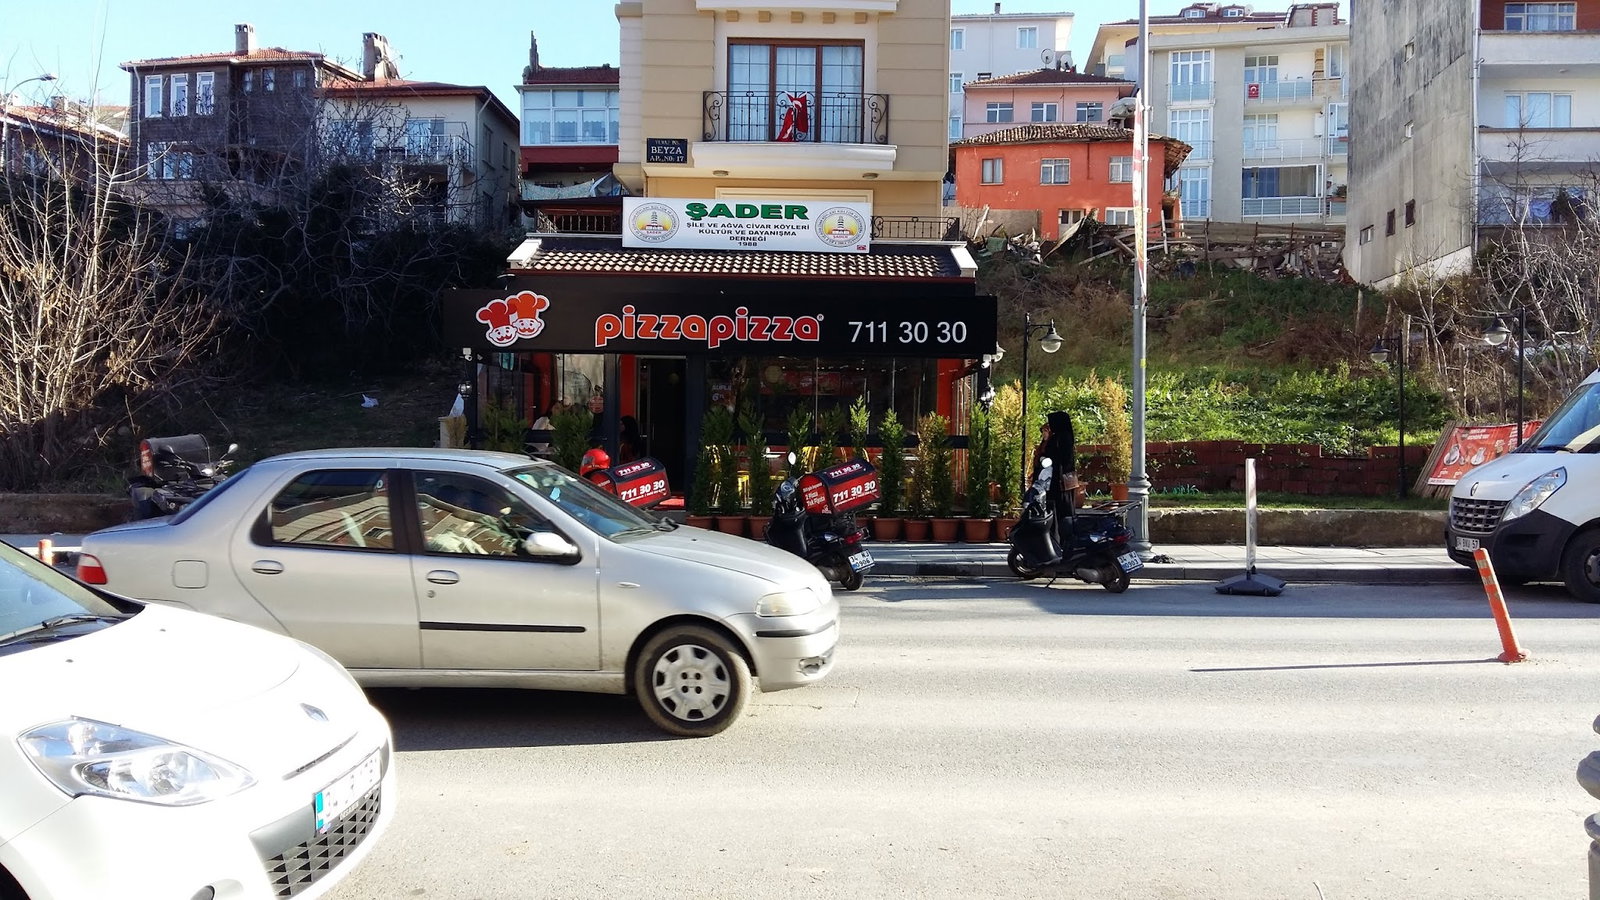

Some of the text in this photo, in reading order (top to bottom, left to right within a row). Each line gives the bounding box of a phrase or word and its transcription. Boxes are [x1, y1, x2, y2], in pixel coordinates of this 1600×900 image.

[651, 146, 682, 154] BEYZA
[685, 202, 810, 221] ŞADER
[848, 321, 967, 343] 711 30 30
[619, 467, 631, 476] 711
[830, 469, 843, 478] 711
[621, 487, 637, 500] 711
[639, 483, 651, 495] 30
[653, 479, 665, 489] 30
[833, 489, 849, 503] 711
[851, 484, 862, 496] 30
[864, 480, 876, 492] 30
